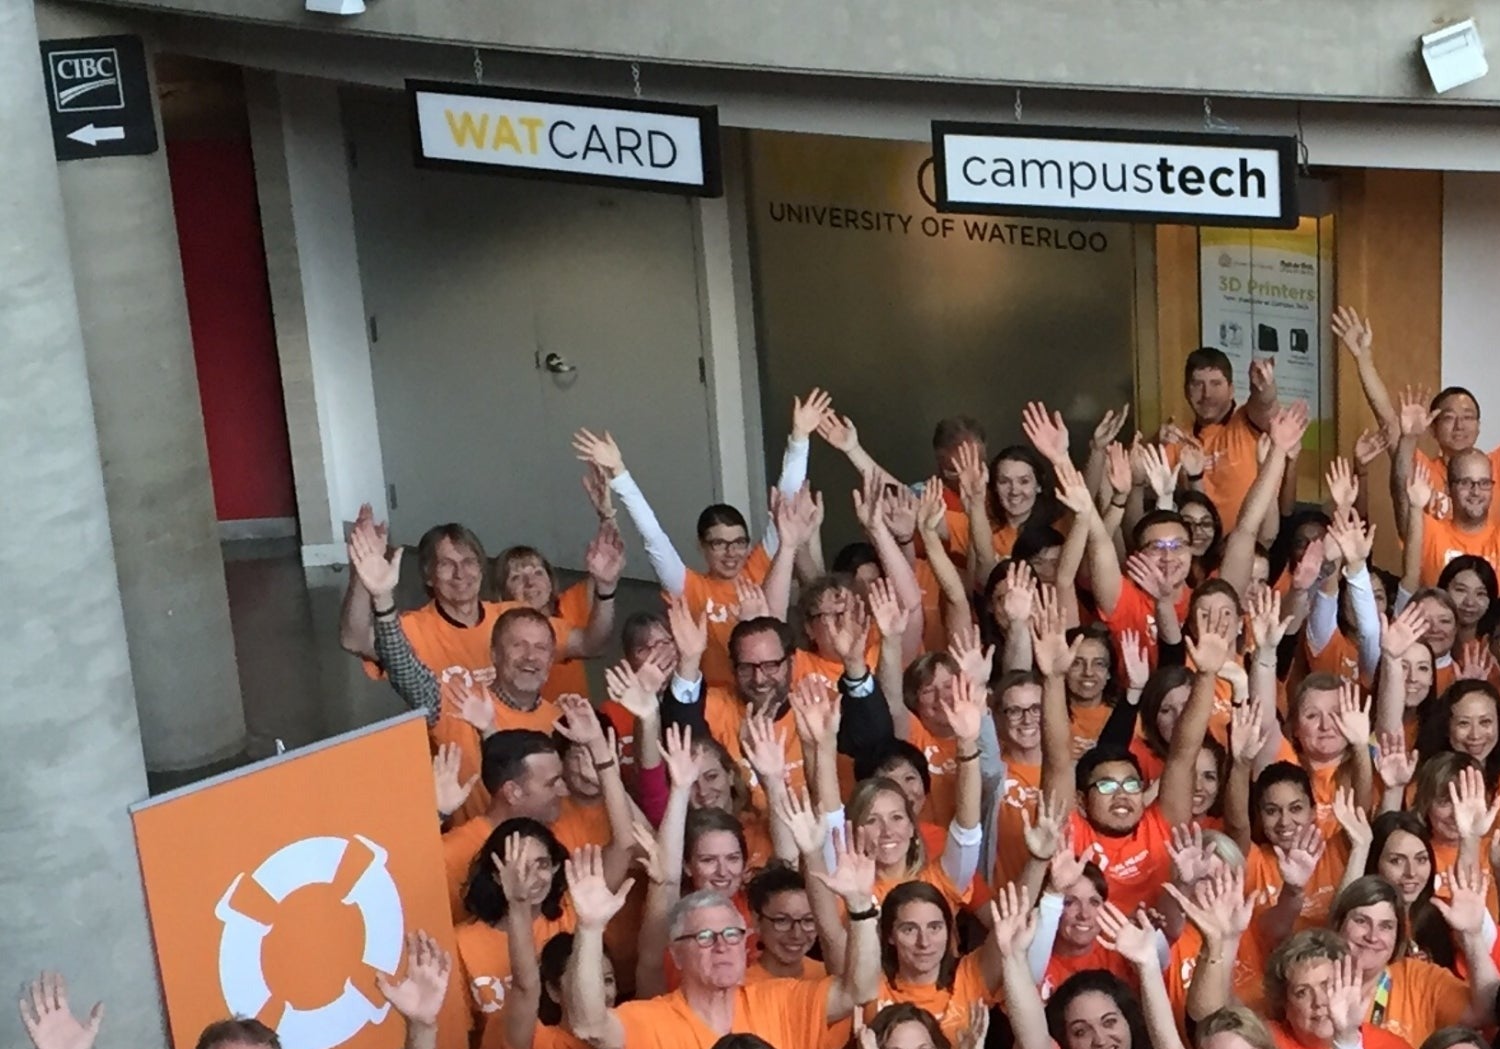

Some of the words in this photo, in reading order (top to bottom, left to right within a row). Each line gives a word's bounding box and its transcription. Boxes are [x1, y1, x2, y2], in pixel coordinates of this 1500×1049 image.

[57, 57, 113, 81] CIBC
[445, 108, 678, 170] WATCARD
[962, 153, 1267, 199] campustech
[769, 202, 913, 235] UNIVERSITY
[921, 216, 955, 239] OF
[964, 220, 1108, 253] WATERLOO
[1218, 275, 1242, 293] 3D
[1248, 279, 1316, 301] Printers
